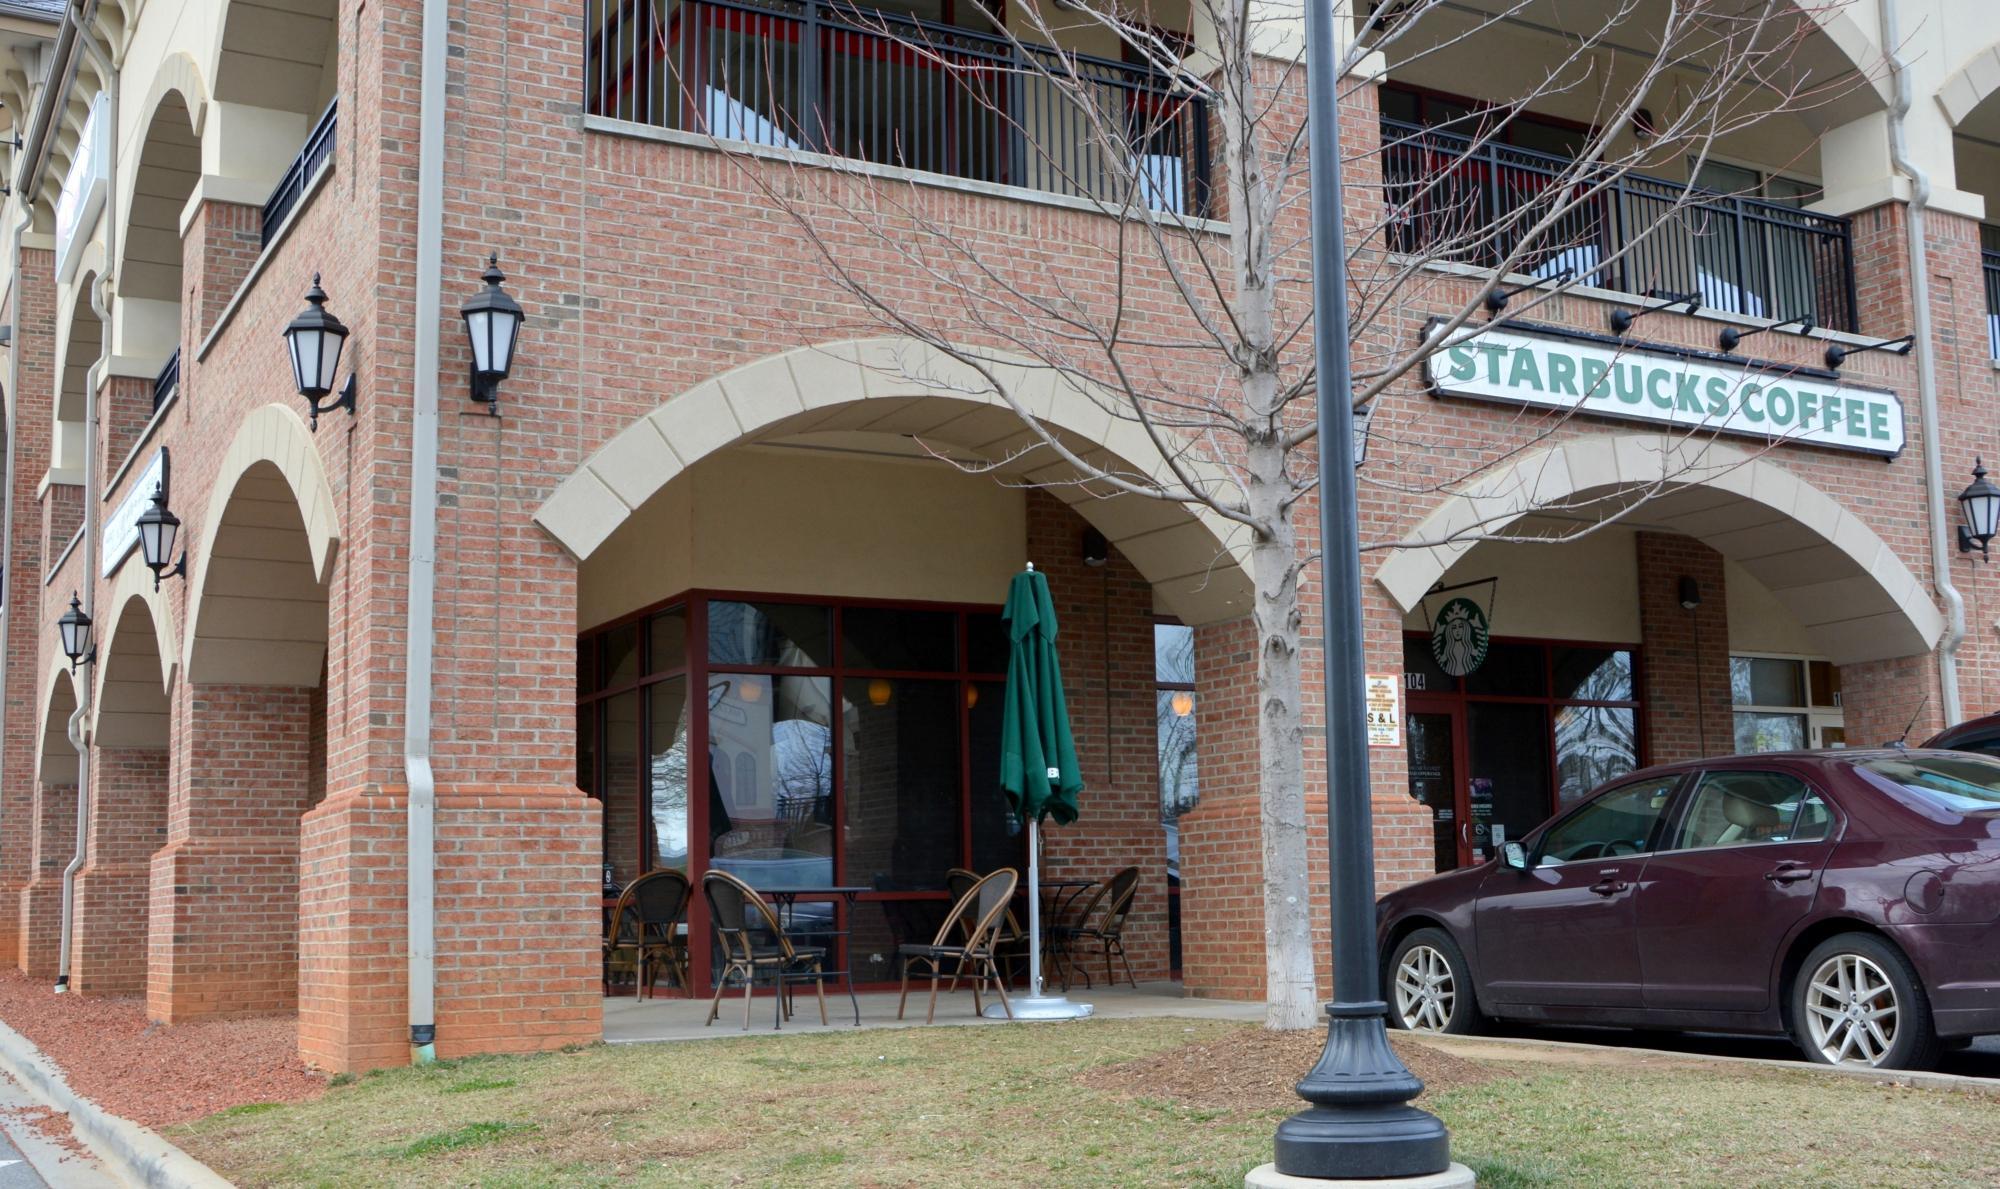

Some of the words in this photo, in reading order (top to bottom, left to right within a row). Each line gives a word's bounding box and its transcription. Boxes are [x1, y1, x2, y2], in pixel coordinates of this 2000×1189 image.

[1449, 340, 1730, 417] STARBUCKS
[1740, 382, 1890, 441] COFFEE
[1404, 673, 1424, 689] 104
[1367, 712, 1374, 723] S
[1378, 712, 1385, 723] &
[1389, 713, 1395, 723] L
